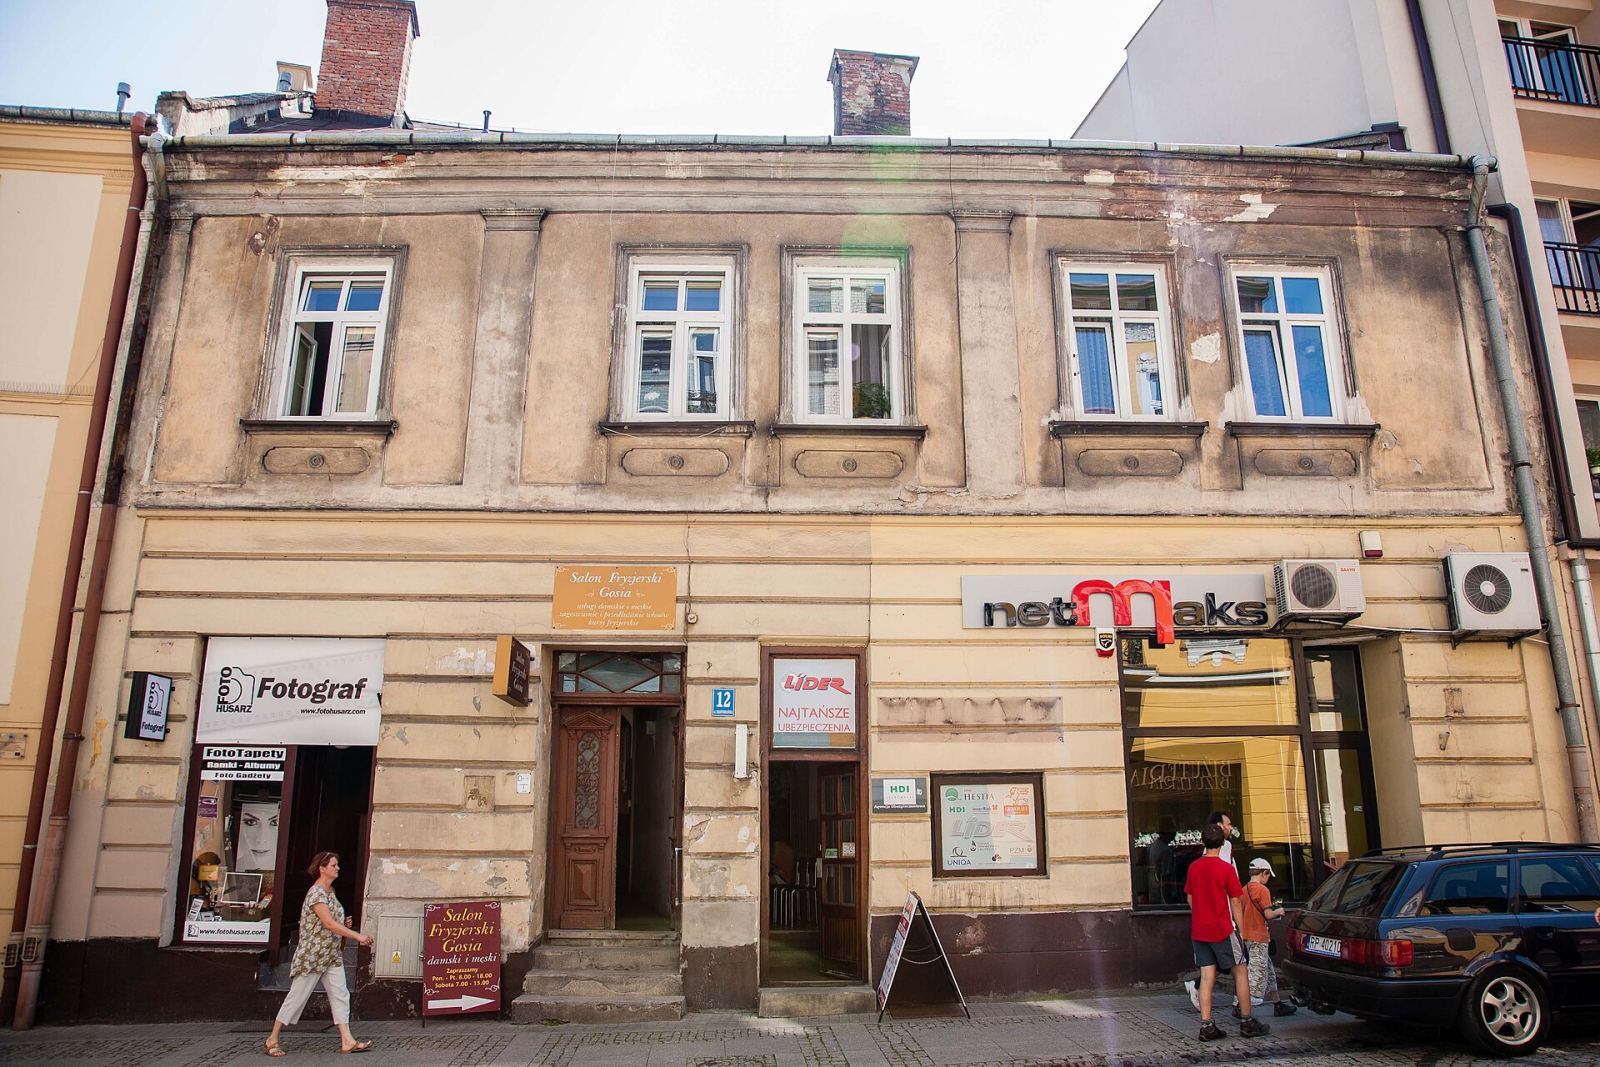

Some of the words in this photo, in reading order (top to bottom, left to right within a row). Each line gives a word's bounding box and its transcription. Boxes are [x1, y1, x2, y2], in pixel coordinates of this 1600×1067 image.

[570, 572, 601, 582] Salon
[608, 572, 663, 586] Fryzjerski
[600, 587, 632, 598] Gosia
[218, 666, 232, 704] FOTO
[257, 678, 368, 704] Fotograf
[717, 691, 731, 708] 12
[216, 705, 252, 713] HUSARZ
[301, 707, 365, 715] www.fotohusarz.com
[778, 705, 849, 720] NAJTAŃSZE
[142, 722, 164, 732] Fotograf
[206, 748, 284, 758] FotoTapety
[244, 762, 280, 770] Albumy
[964, 793, 995, 801] HESTIA
[443, 908, 482, 921] Salon
[429, 921, 495, 940] Fryzjerski
[443, 938, 482, 953] Gosia
[427, 954, 460, 965] damski
[472, 952, 497, 964] męski
